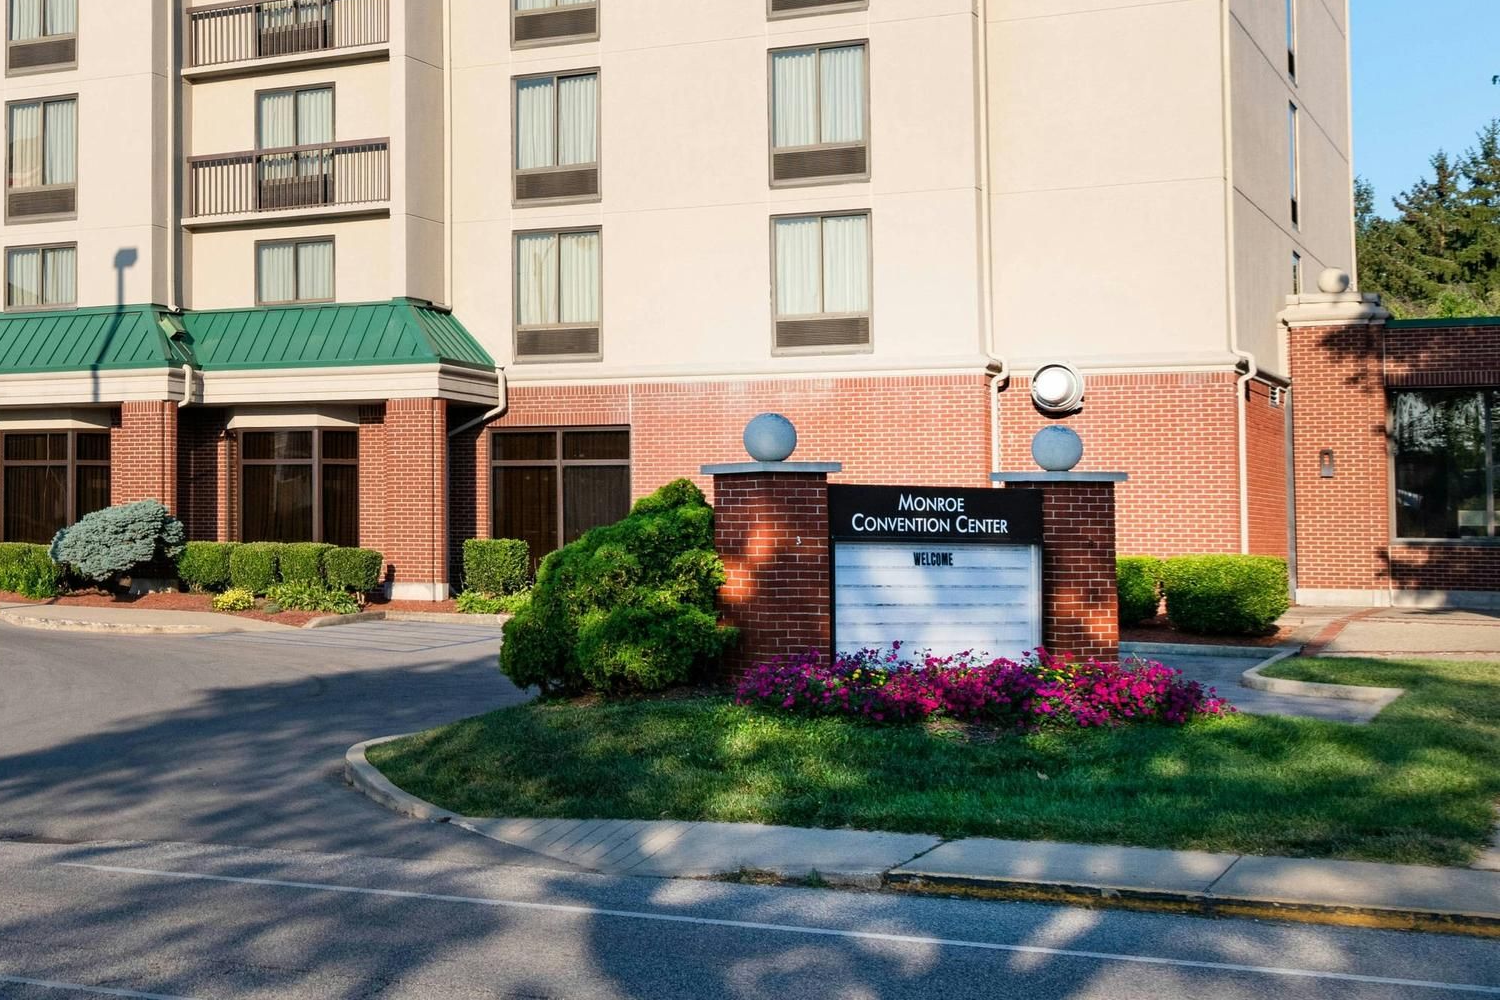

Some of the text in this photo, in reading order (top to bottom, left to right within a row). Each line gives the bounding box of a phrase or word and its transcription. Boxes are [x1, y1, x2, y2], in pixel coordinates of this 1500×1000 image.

[898, 493, 965, 512] MONROE
[851, 513, 1008, 534] CONVENTION CENTER
[913, 552, 954, 566] WELCOME
